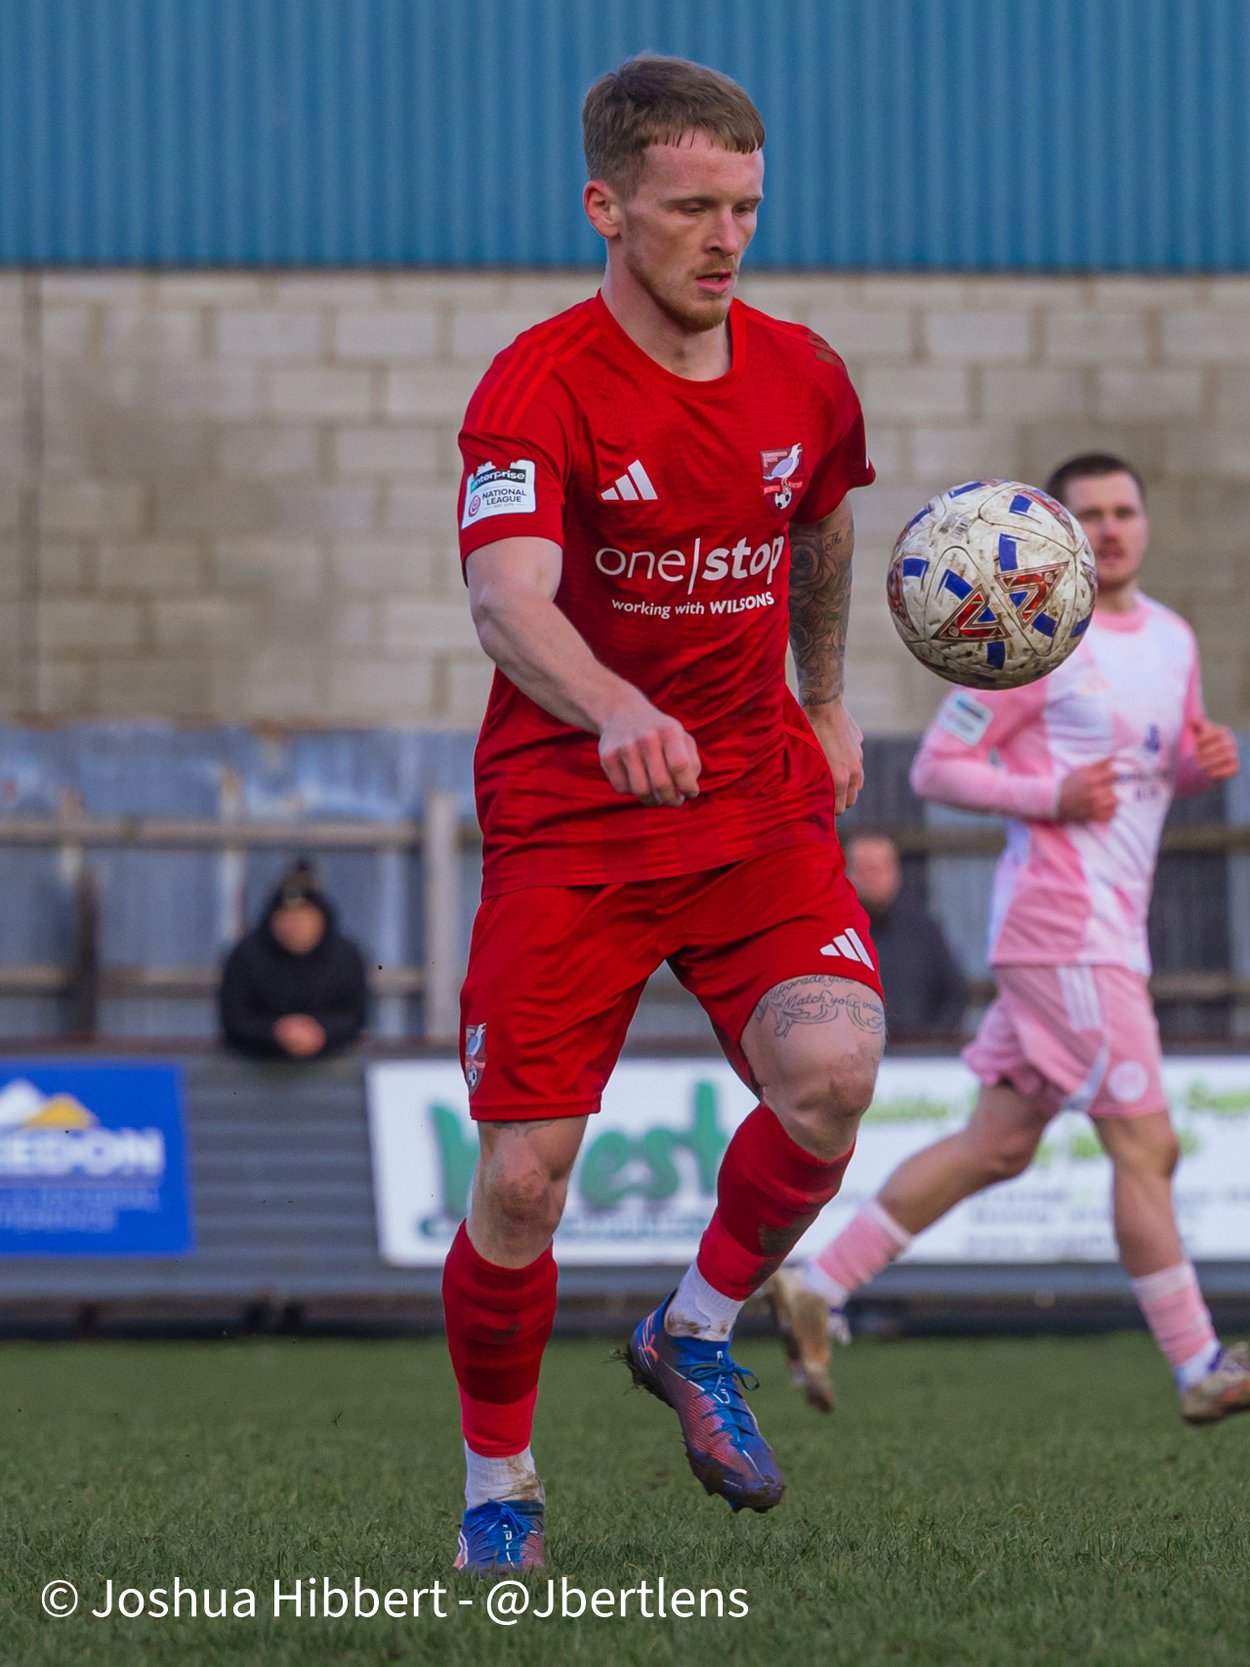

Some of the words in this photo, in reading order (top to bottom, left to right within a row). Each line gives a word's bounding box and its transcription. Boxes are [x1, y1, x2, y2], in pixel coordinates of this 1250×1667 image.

[482, 488, 527, 500] NATIONAL
[486, 495, 522, 506] LEAGUE
[611, 599, 672, 620] working
[674, 602, 705, 615] with
[709, 591, 775, 615] WILSONS
